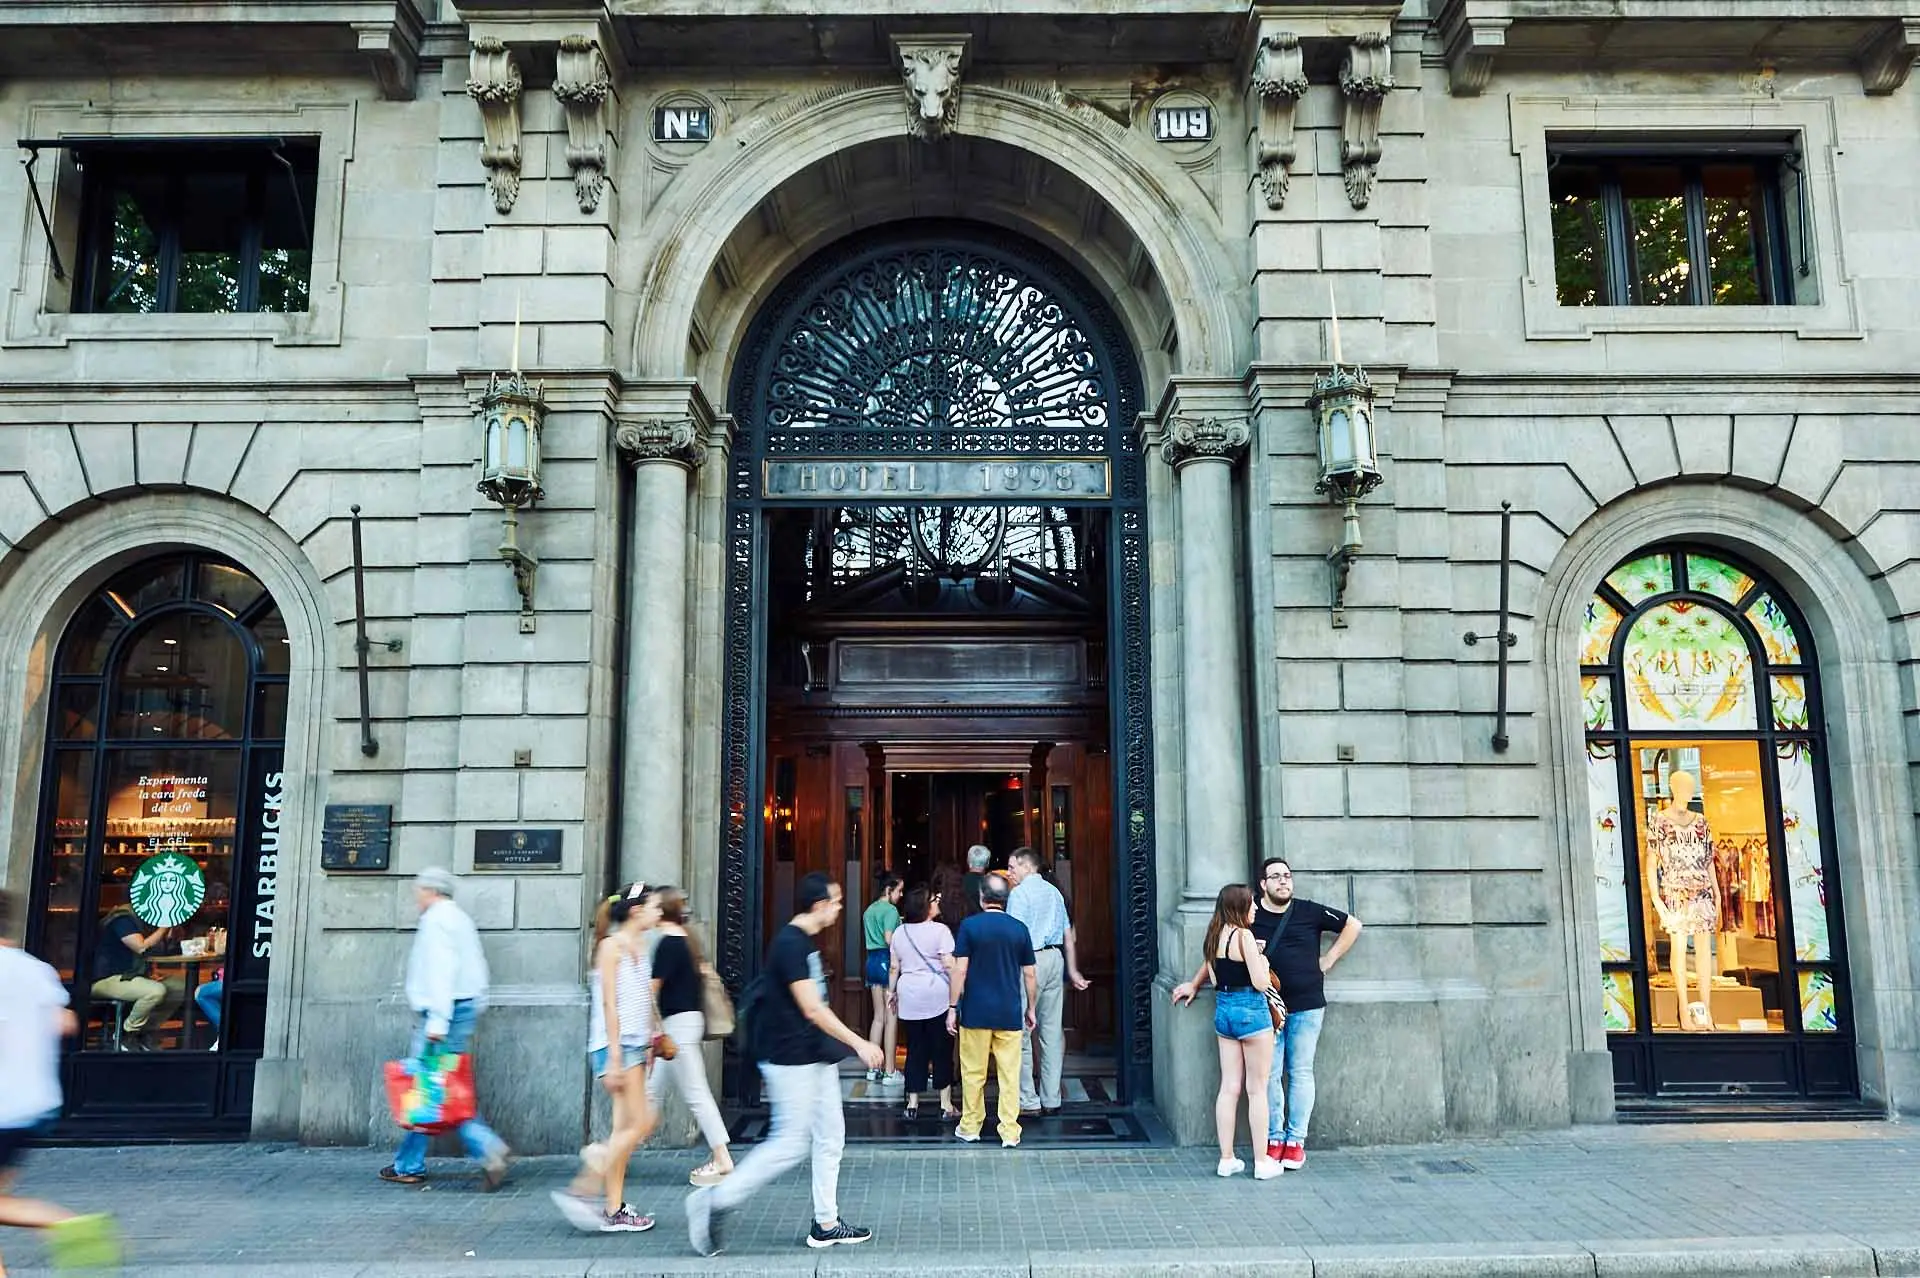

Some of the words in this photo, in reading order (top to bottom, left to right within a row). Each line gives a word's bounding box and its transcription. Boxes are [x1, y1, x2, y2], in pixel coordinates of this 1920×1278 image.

[1158, 108, 1207, 138] 109
[799, 463, 925, 491] HOTEL
[981, 463, 1075, 491] 1898
[138, 775, 208, 787] Experimenta
[139, 789, 149, 800] la
[151, 790, 175, 800] cara
[176, 788, 206, 800] freda
[151, 802, 168, 813] del
[149, 838, 162, 847] EL
[167, 837, 188, 847] GEL
[253, 772, 284, 958] STARBUCKS
